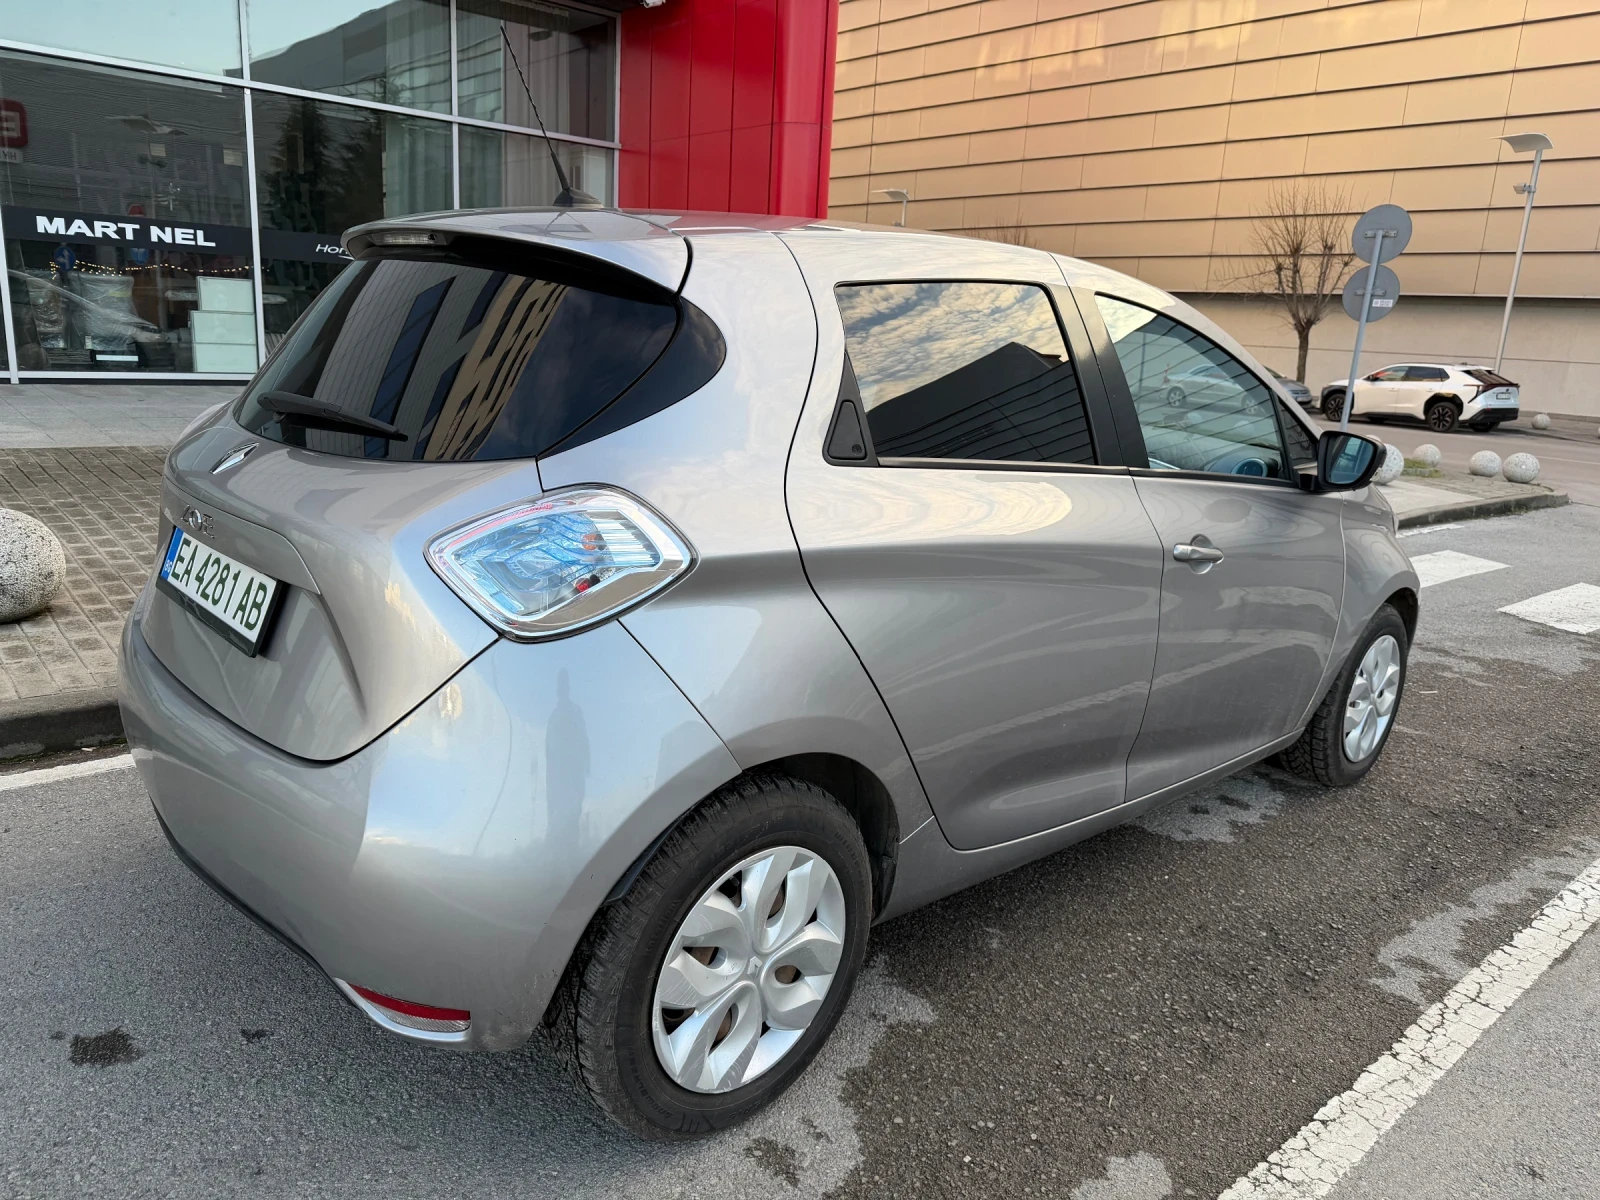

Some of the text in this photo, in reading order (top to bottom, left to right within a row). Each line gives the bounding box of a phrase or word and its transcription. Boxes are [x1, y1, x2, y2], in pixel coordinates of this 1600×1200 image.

[35, 215, 216, 247] MART NEL
[171, 537, 268, 631] EA 4281 AB
